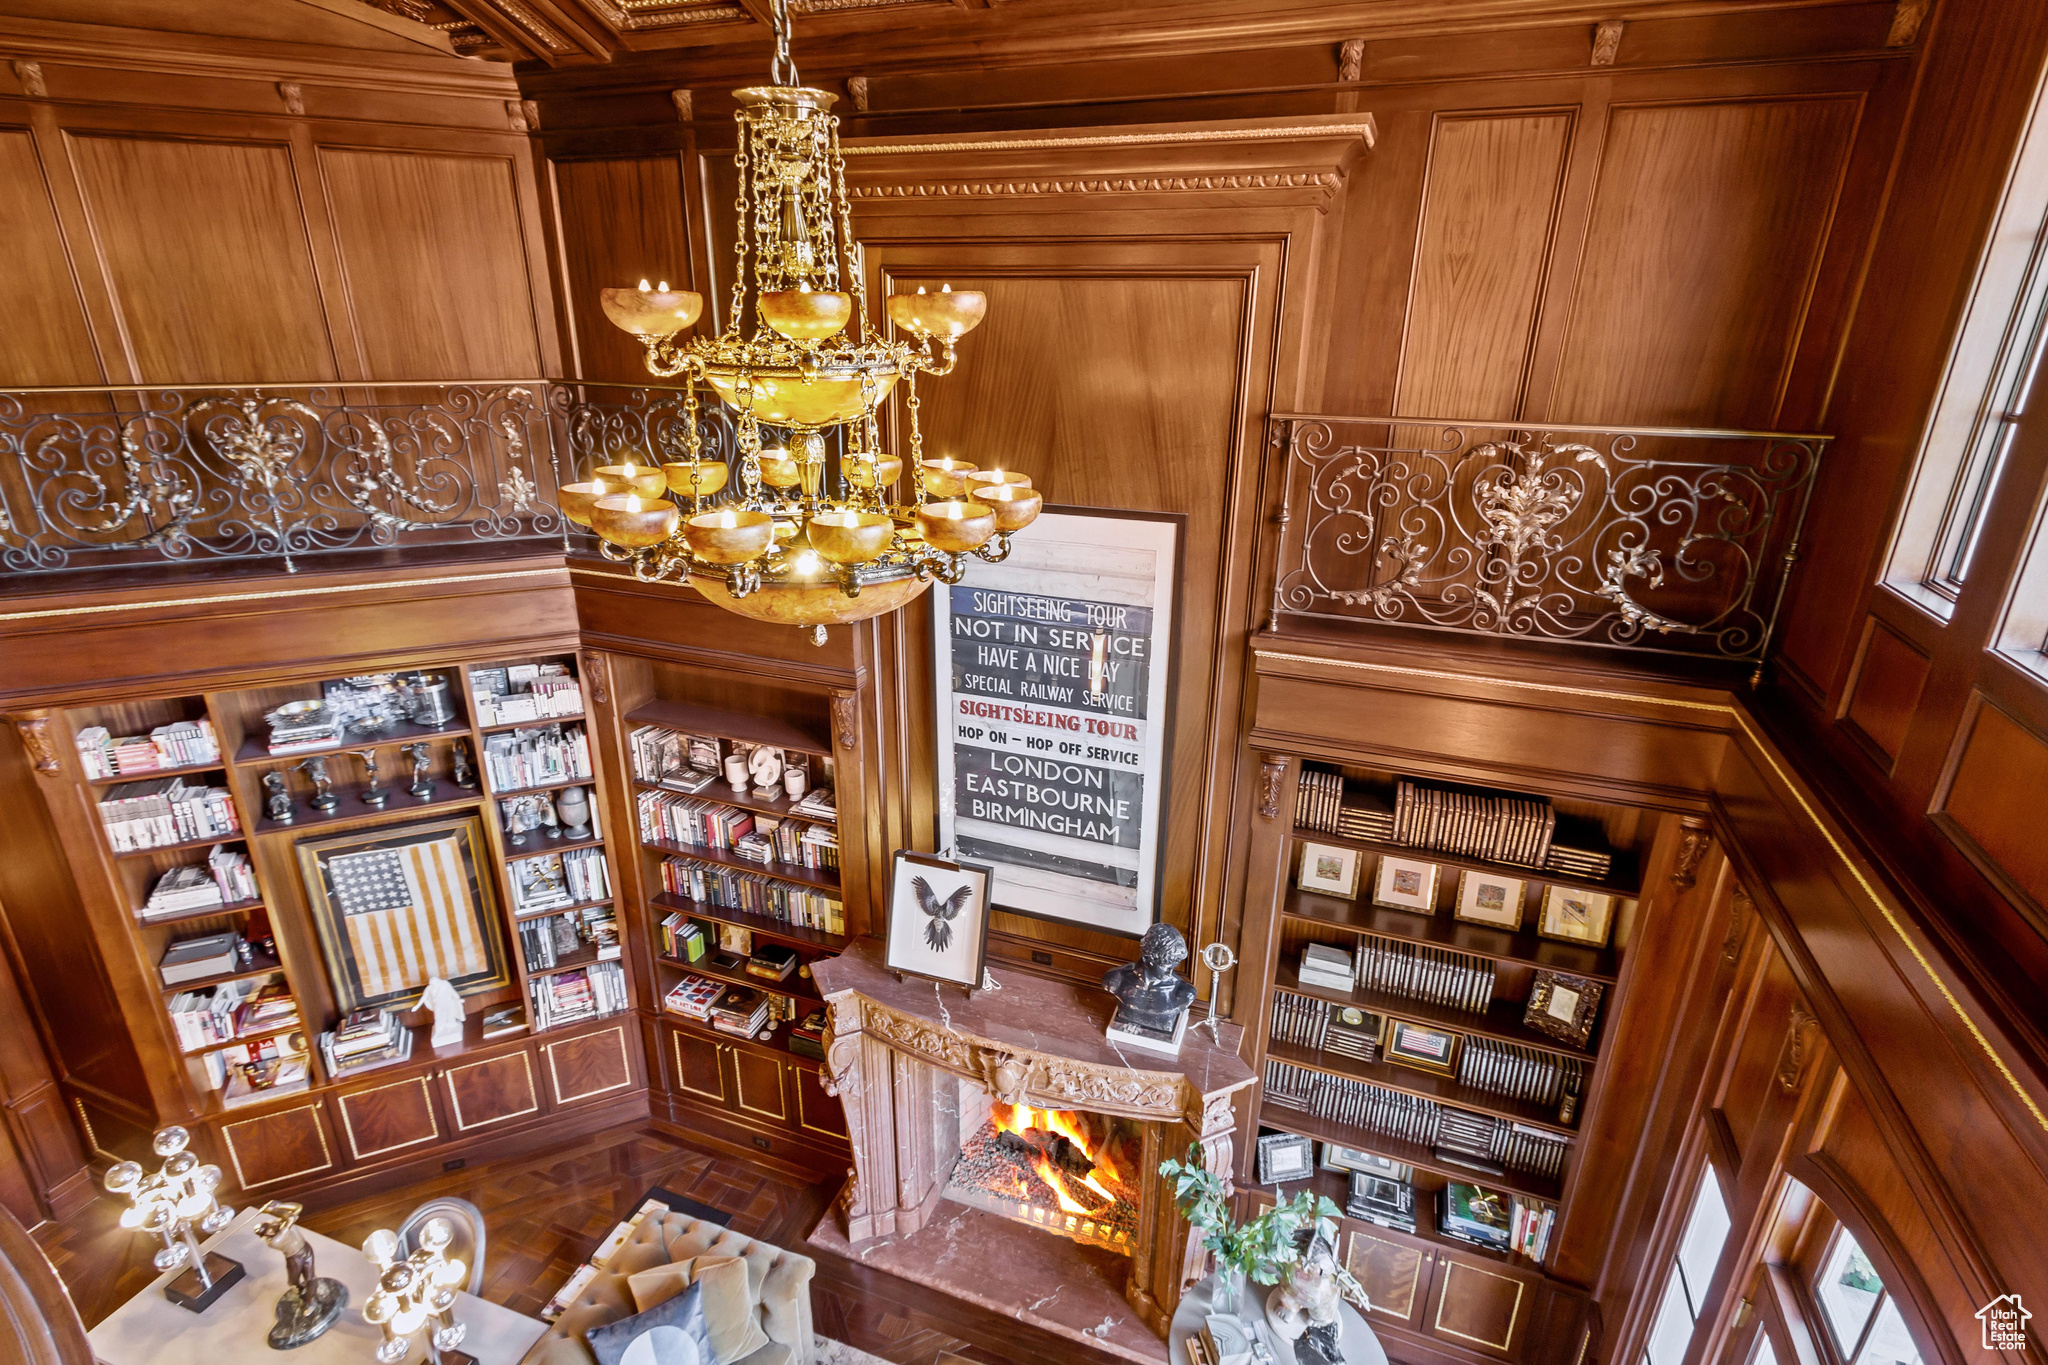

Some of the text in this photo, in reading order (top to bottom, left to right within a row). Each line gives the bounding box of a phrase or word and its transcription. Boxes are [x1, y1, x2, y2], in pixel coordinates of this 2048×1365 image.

[974, 592, 1126, 628] SIGHTSEEING TOUR
[955, 618, 1144, 657] NOT IN SERVICE
[978, 646, 1119, 683] HAVE A NICE DAY
[965, 674, 1133, 711] SPECIAL RAILWAY SERVICE
[960, 700, 1138, 741] SIGHTSEEING TOUR
[958, 726, 984, 740] HOP
[989, 731, 1007, 744] ON
[1027, 737, 1053, 751] HOP
[1059, 742, 1082, 756] OFF
[1087, 746, 1138, 765] SERVICE
[991, 753, 1103, 789] LONDON
[966, 773, 1130, 820] EASTBOURNE
[973, 799, 1120, 843] BIRMINGHAM
[669, 975, 701, 997] THE
